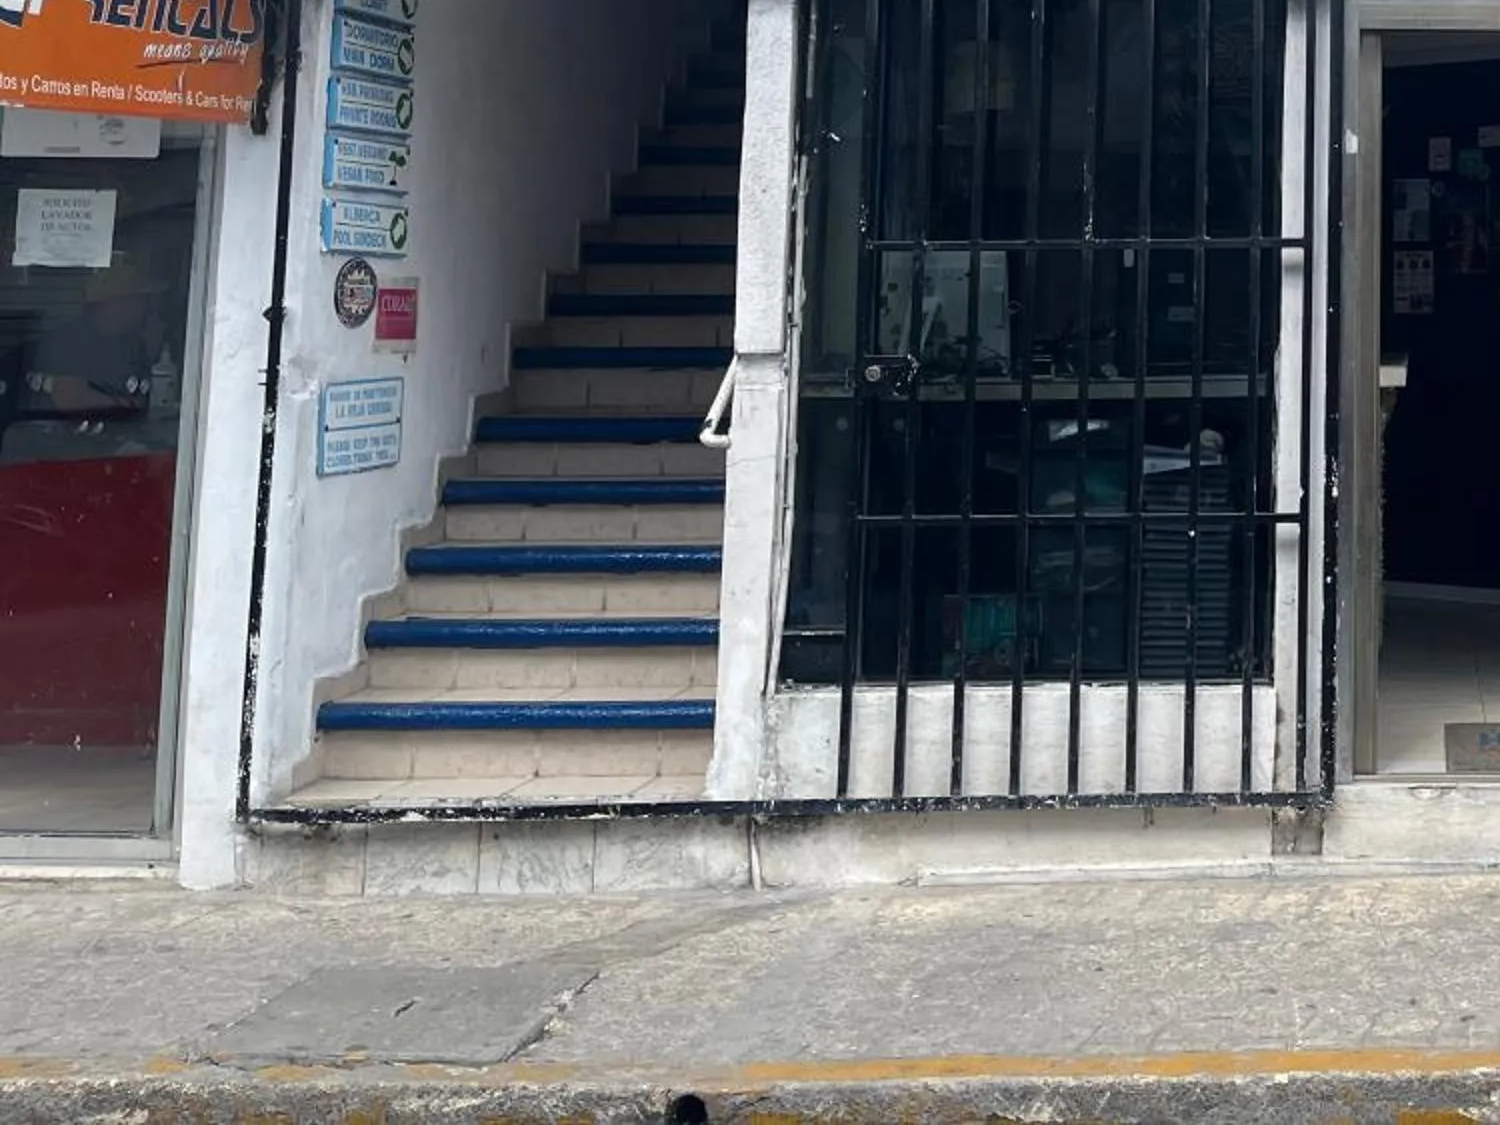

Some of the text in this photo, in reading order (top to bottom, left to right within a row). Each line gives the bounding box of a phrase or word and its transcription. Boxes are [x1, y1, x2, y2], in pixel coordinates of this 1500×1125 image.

[31, 74, 71, 96] Carros
[73, 82, 89, 97] en
[91, 80, 125, 100] Renta
[134, 83, 183, 105] Scooters
[195, 90, 219, 108] Cars
